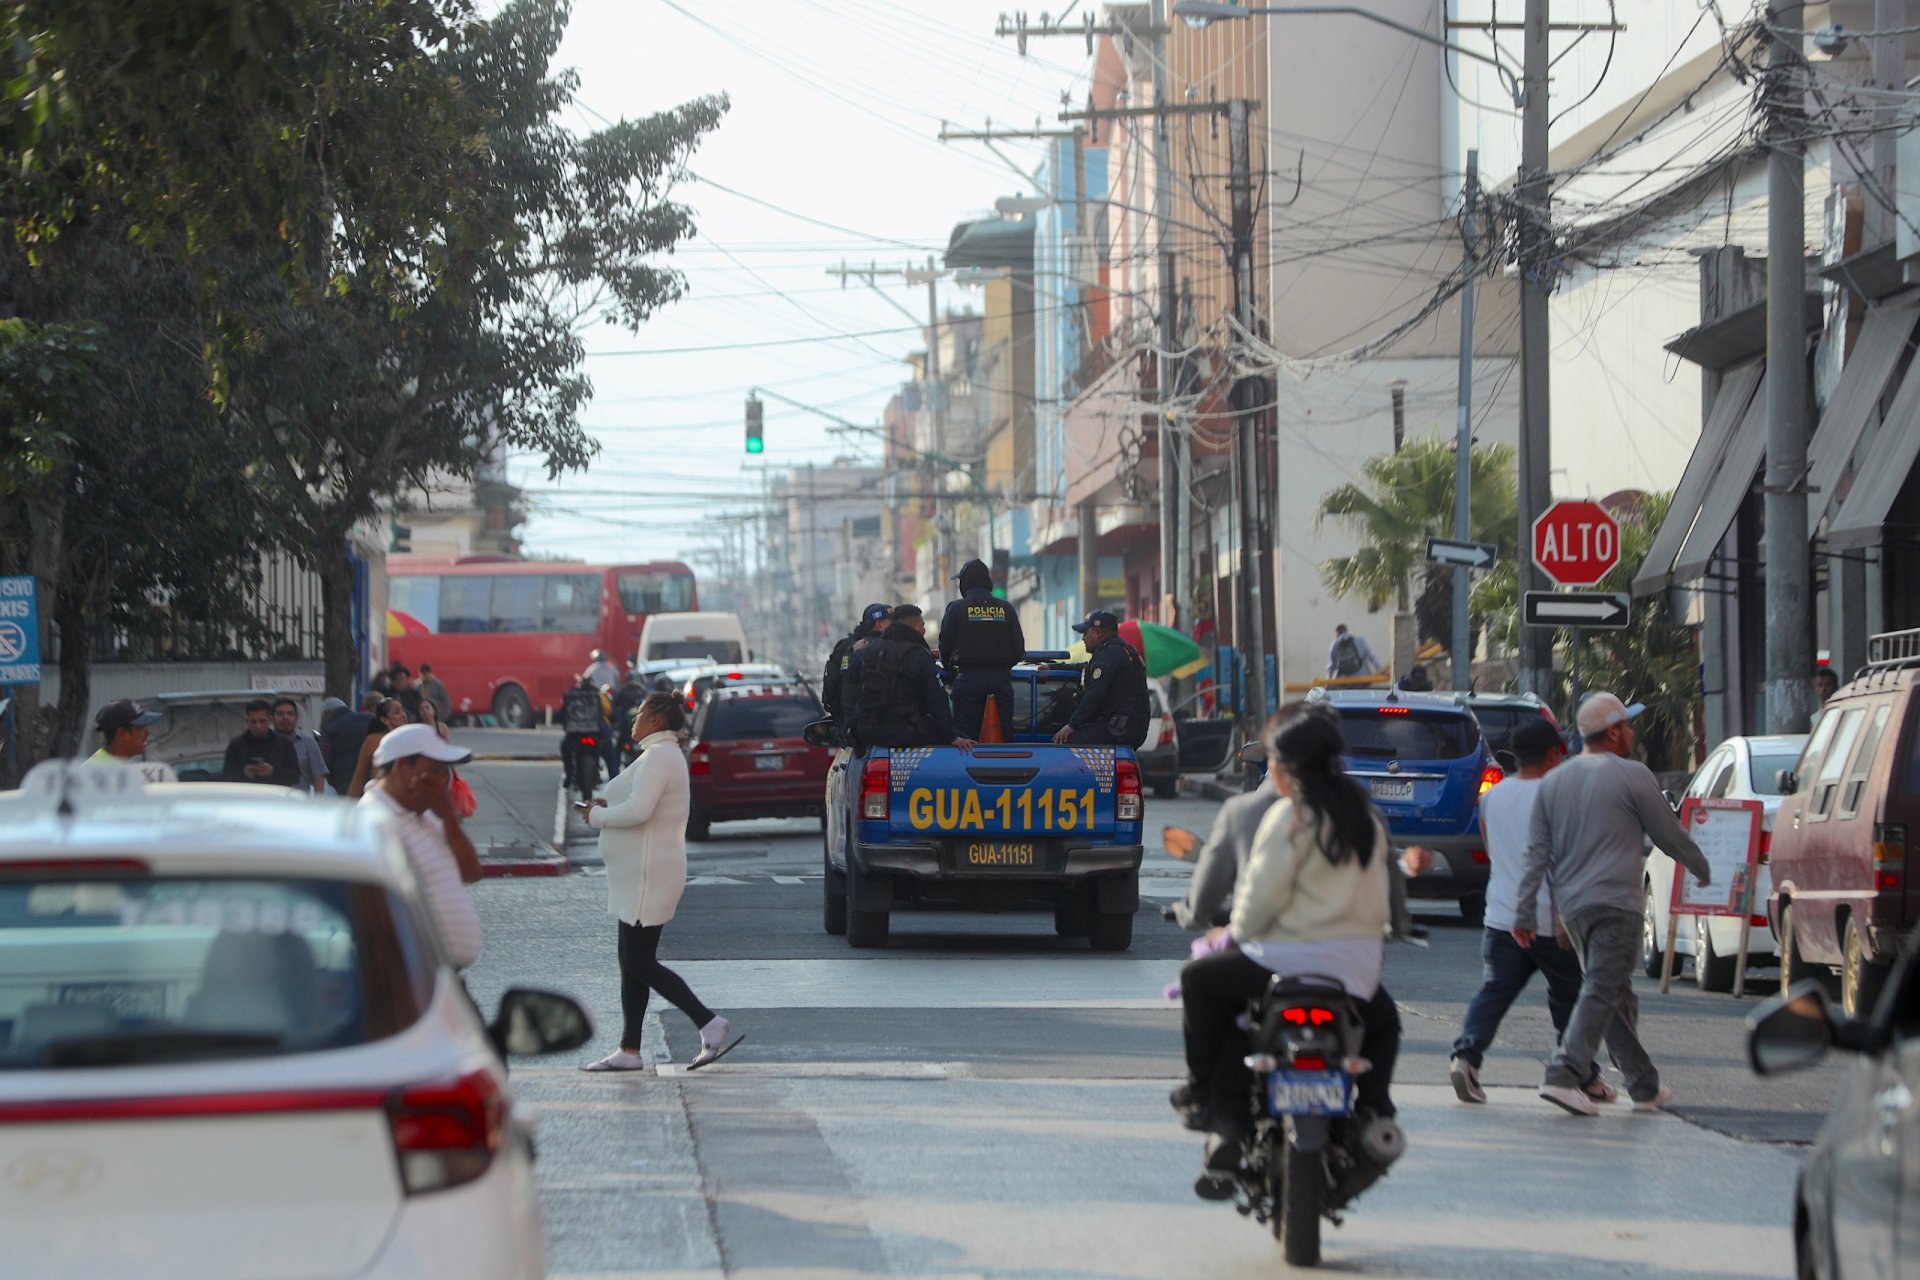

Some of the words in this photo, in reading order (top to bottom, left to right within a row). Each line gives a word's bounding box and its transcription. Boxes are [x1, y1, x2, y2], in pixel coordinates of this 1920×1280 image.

[1541, 523, 1612, 562] ALTO
[967, 606, 1005, 614] POLICIA
[908, 787, 1096, 830] GUA-11151
[969, 844, 1033, 865] GUA-11151
